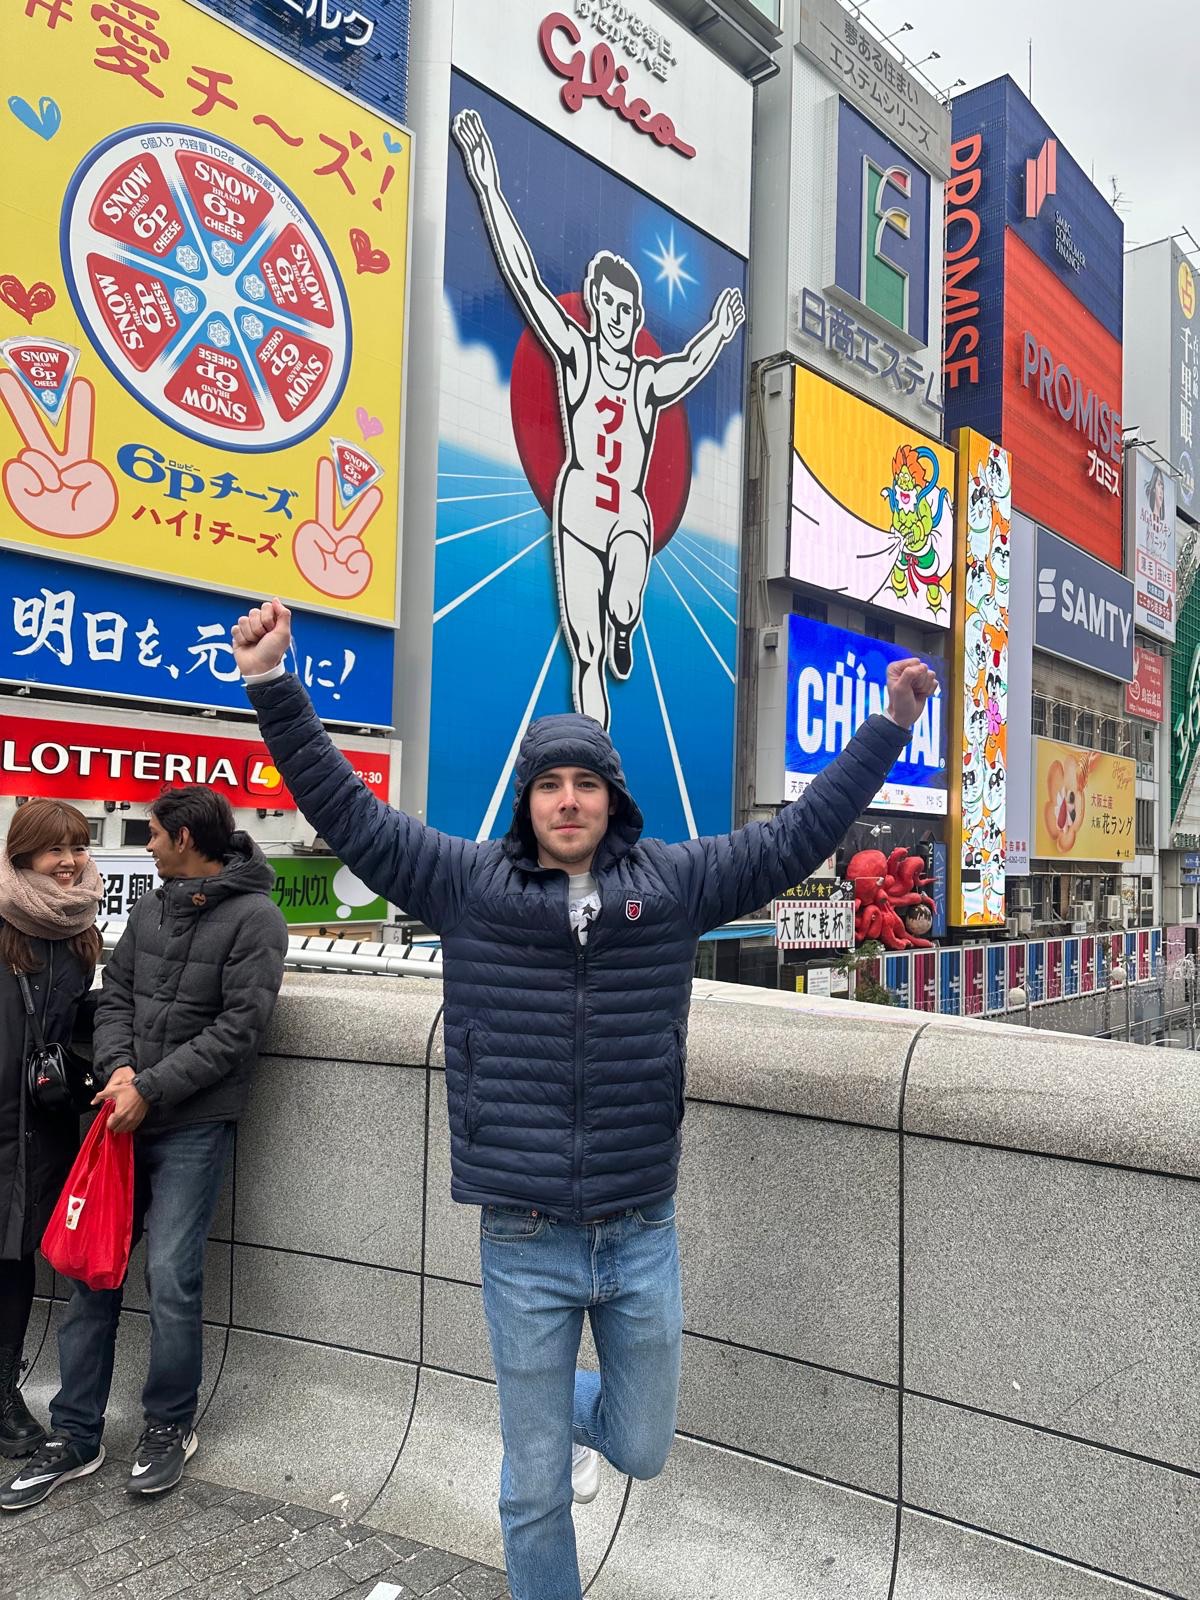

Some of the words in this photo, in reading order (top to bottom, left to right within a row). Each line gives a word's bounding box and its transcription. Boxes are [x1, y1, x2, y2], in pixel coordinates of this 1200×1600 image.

[283, 0, 375, 47] ルク
[844, 19, 919, 105] 夢ある住まい
[537, 12, 697, 159] Glico
[830, 42, 930, 151] エステムシリーズ
[102, 163, 152, 224] SNOW
[195, 161, 259, 205] SNOW
[212, 186, 241, 205] BRAND
[128, 194, 150, 219] BRAND
[153, 220, 182, 253] CHEESE
[204, 216, 244, 241] CHEESE
[290, 243, 328, 311] SNOW
[292, 264, 306, 294] BRAND
[942, 134, 982, 388] PROMISE
[263, 262, 285, 304] CHEESE
[92, 272, 144, 350] SNOW
[123, 292, 143, 326] BRAND
[151, 281, 177, 327] CHEESE
[20, 350, 59, 364] SNOW
[198, 347, 238, 370] CHEESE
[258, 331, 283, 362] CHEESE
[284, 354, 323, 411] SNOW
[286, 360, 303, 383] BRAND
[181, 386, 247, 423] SNOW
[201, 384, 230, 399] BRAND
[1023, 330, 1121, 464] PROMISE
[343, 450, 370, 472] SNOW
[344, 464, 362, 480] 6P
[595, 395, 626, 514] グリコ
[1087, 450, 1121, 498] プロミス
[1061, 578, 1132, 648] SAMTY
[12, 588, 356, 699] 明日を、元に!
[3, 740, 239, 786] LOTTERIA
[1091, 793, 1113, 809] 大阪土産
[928, 842, 934, 869] 2F
[782, 883, 834, 898] 阪もんを食す
[780, 909, 844, 940] 大阪に乾杯
